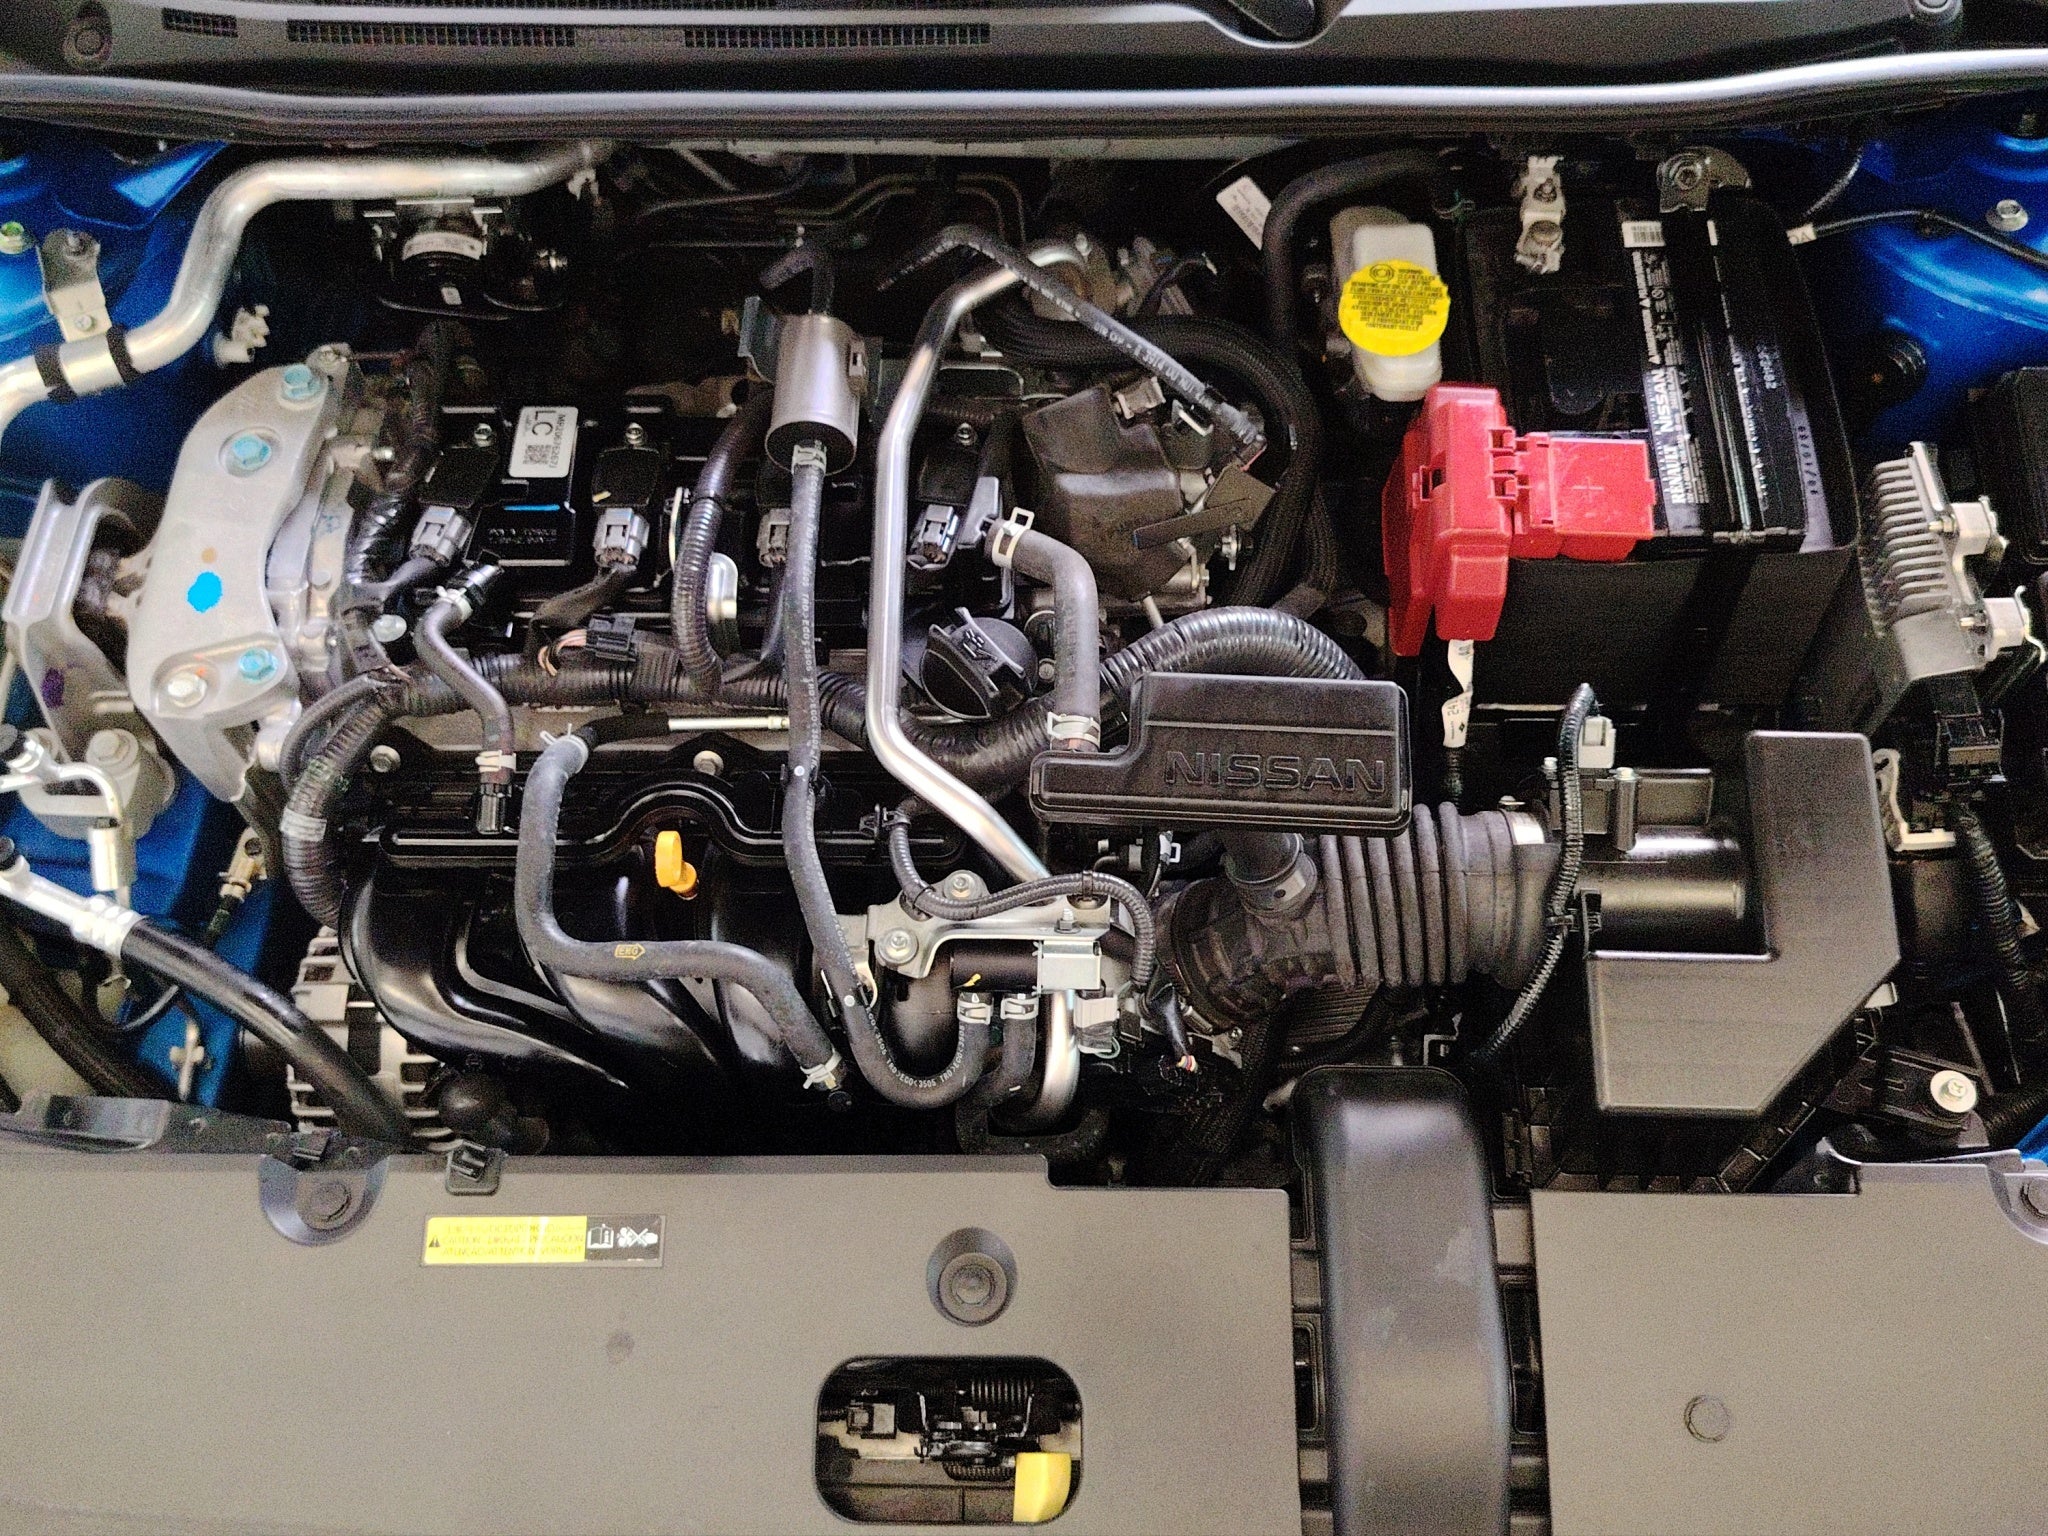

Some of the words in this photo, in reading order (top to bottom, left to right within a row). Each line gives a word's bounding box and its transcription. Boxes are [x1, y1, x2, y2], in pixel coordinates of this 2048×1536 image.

[1651, 367, 1674, 433] NISSAN
[1663, 444, 1686, 504] RENAULT
[1164, 750, 1386, 793] NISSAN
